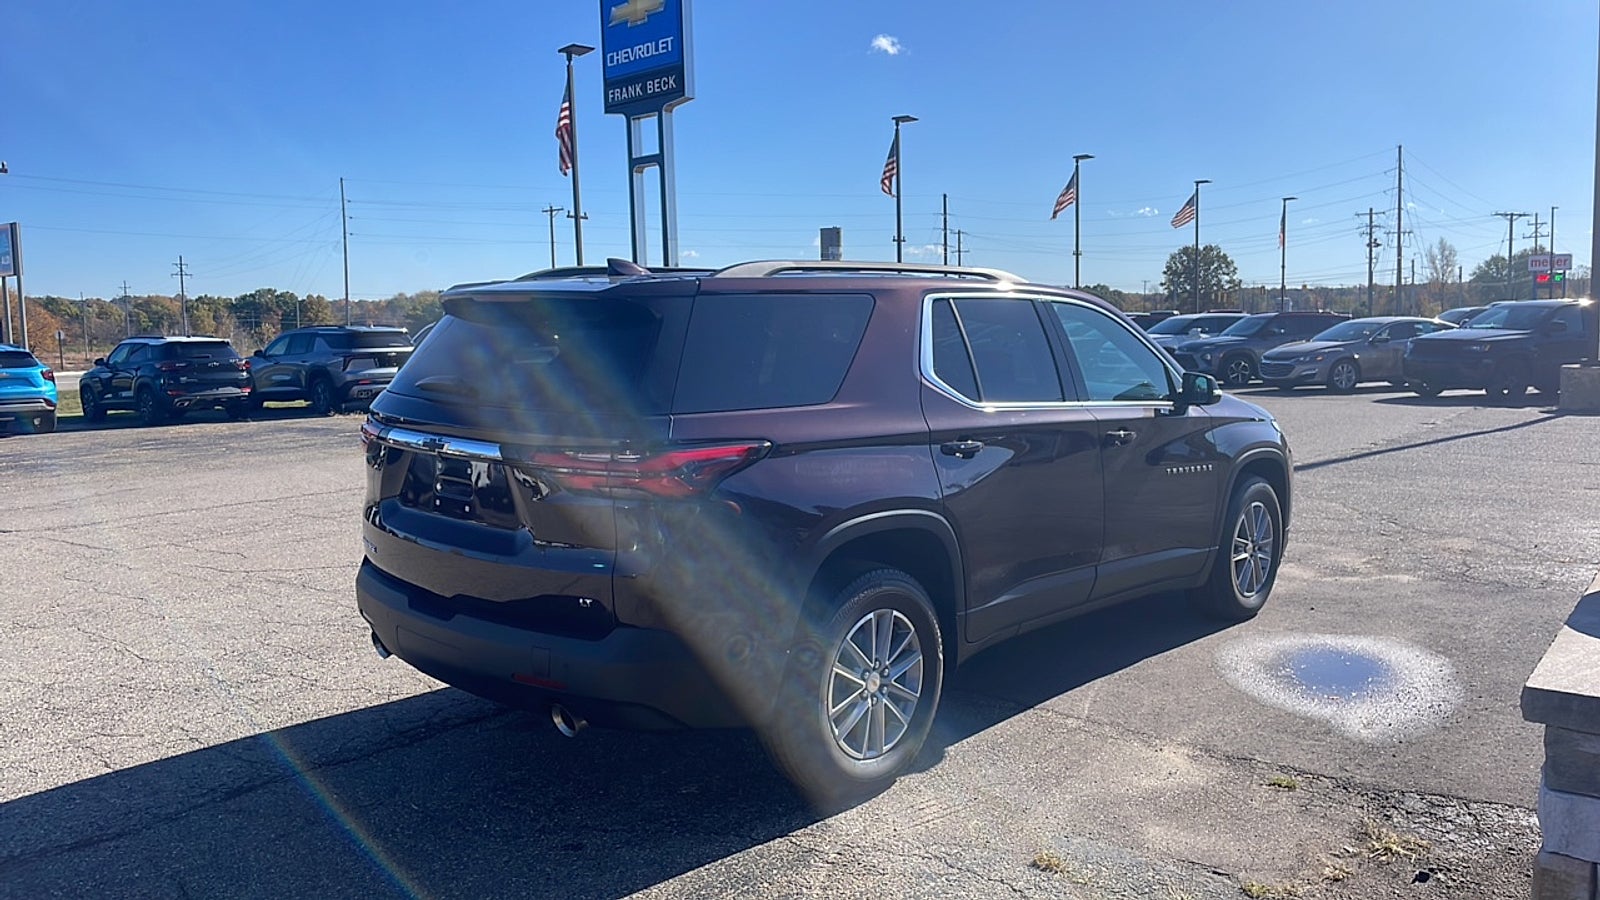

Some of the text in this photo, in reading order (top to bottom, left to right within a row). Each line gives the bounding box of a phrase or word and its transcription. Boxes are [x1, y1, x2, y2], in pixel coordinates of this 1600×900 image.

[606, 36, 674, 67] CHEVROLET
[608, 75, 677, 103] FRANK BECK
